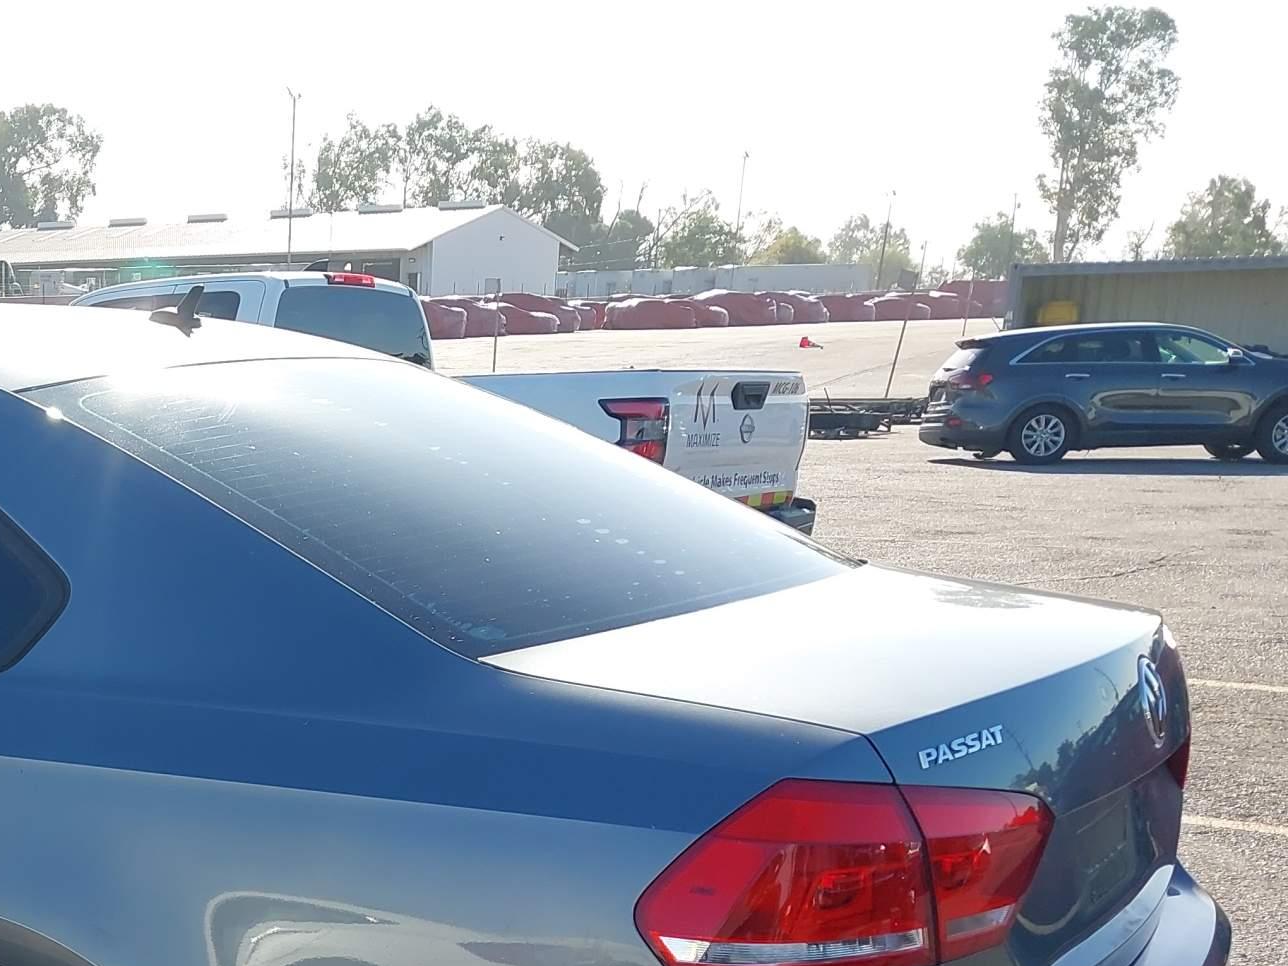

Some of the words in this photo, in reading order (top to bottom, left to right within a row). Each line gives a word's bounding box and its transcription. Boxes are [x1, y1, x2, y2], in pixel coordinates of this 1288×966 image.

[686, 433, 721, 448] MAXIMIZE
[711, 472, 732, 488] Makes
[733, 472, 762, 488] Frequent
[762, 470, 780, 487] Stops
[918, 724, 1003, 770] PASSAT
